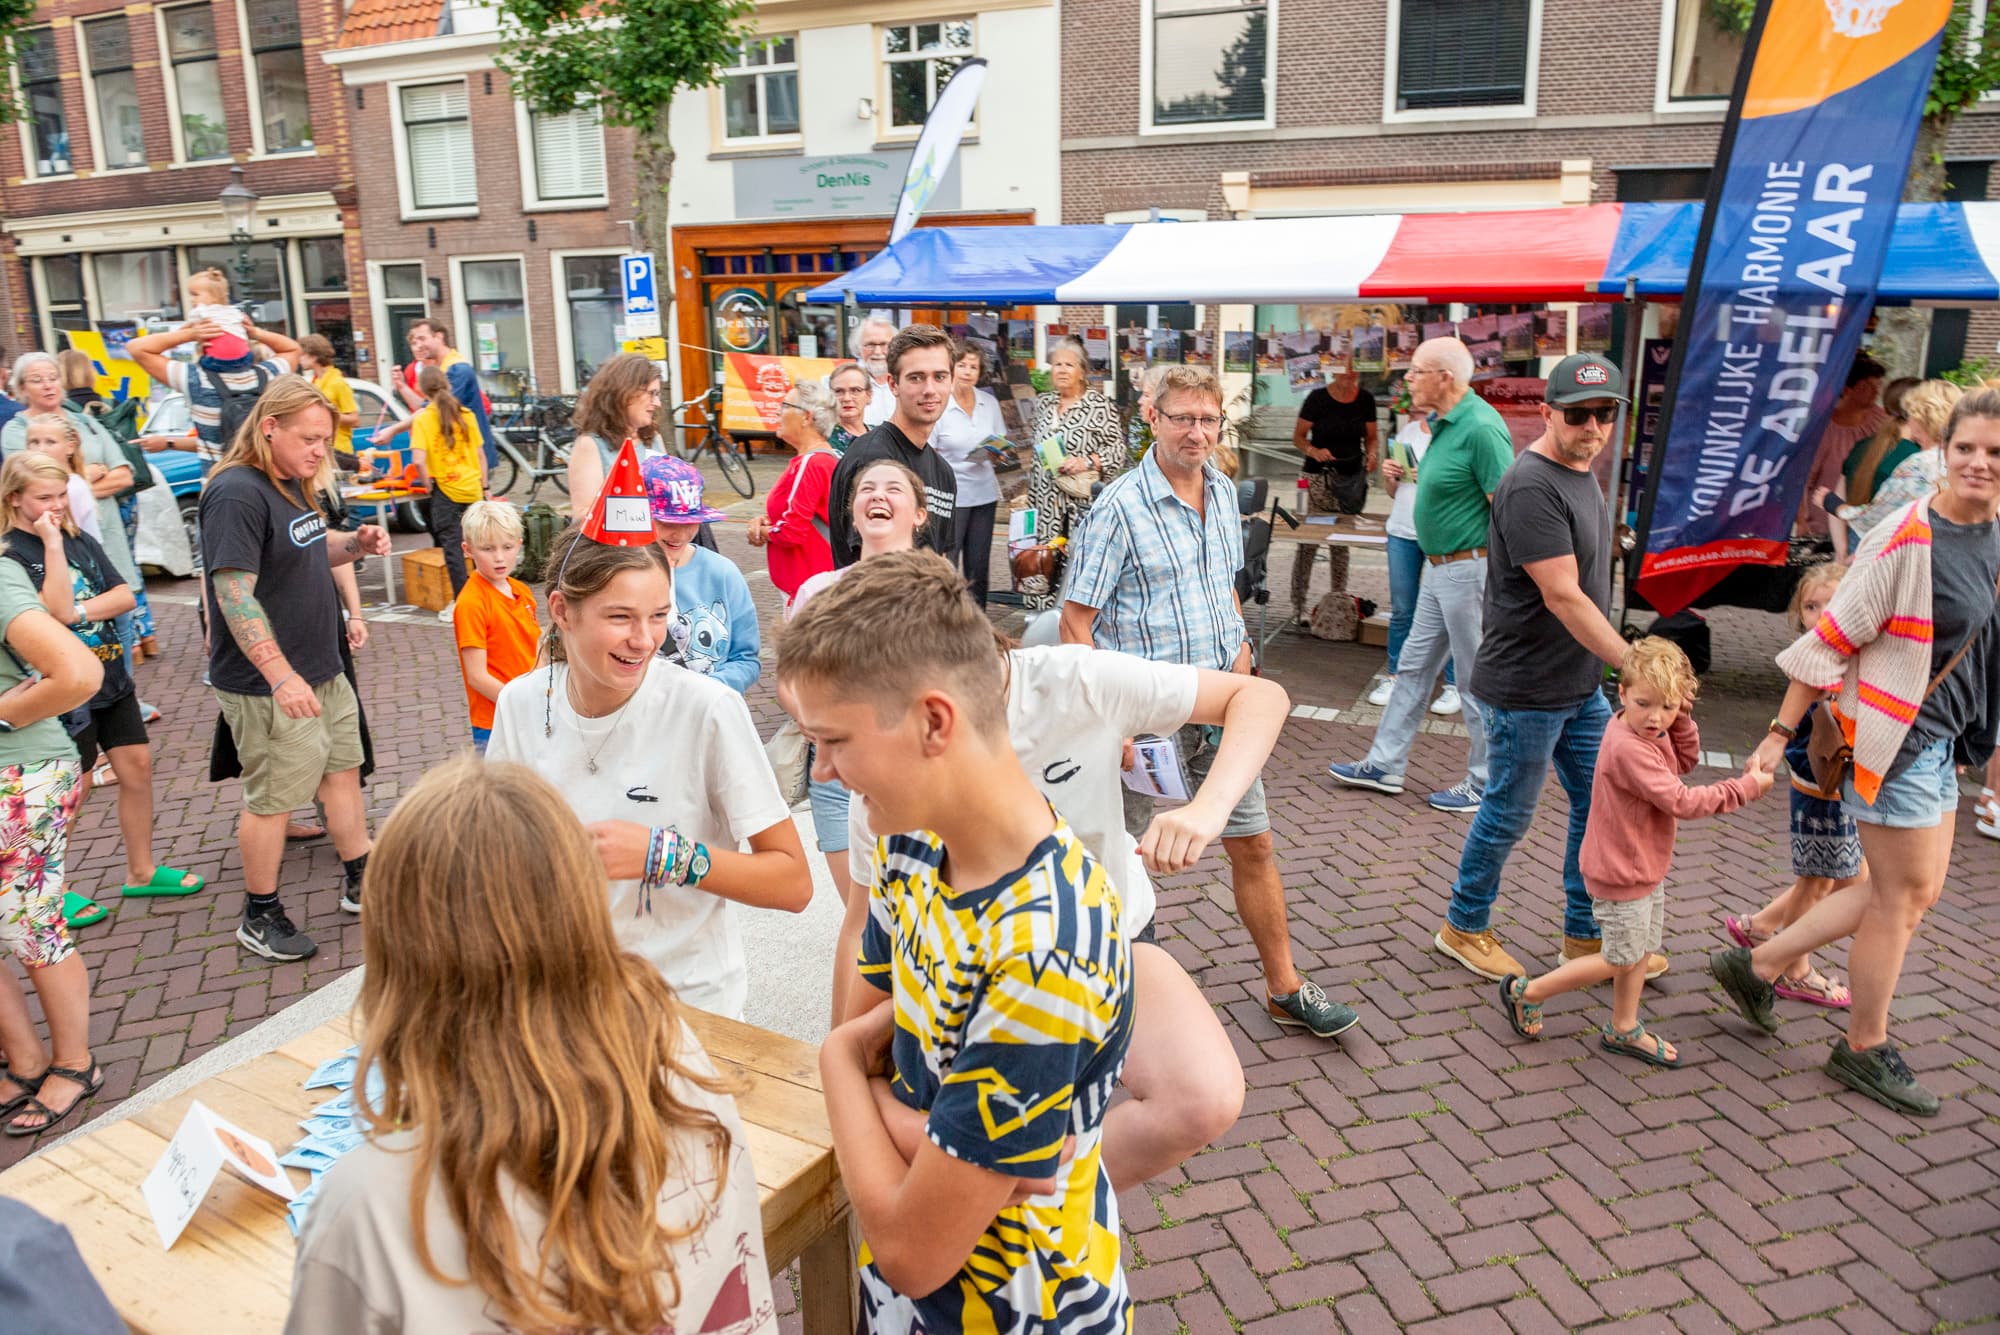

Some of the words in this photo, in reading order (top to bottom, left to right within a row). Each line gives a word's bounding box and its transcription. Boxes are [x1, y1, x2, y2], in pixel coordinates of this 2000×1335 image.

[817, 172, 871, 188] DenNis
[1731, 160, 1805, 325] HARMONIE
[628, 260, 648, 291] P
[716, 316, 769, 329] DenNis
[1728, 454, 1788, 517] DE
[1760, 162, 1874, 443] ADELAAR
